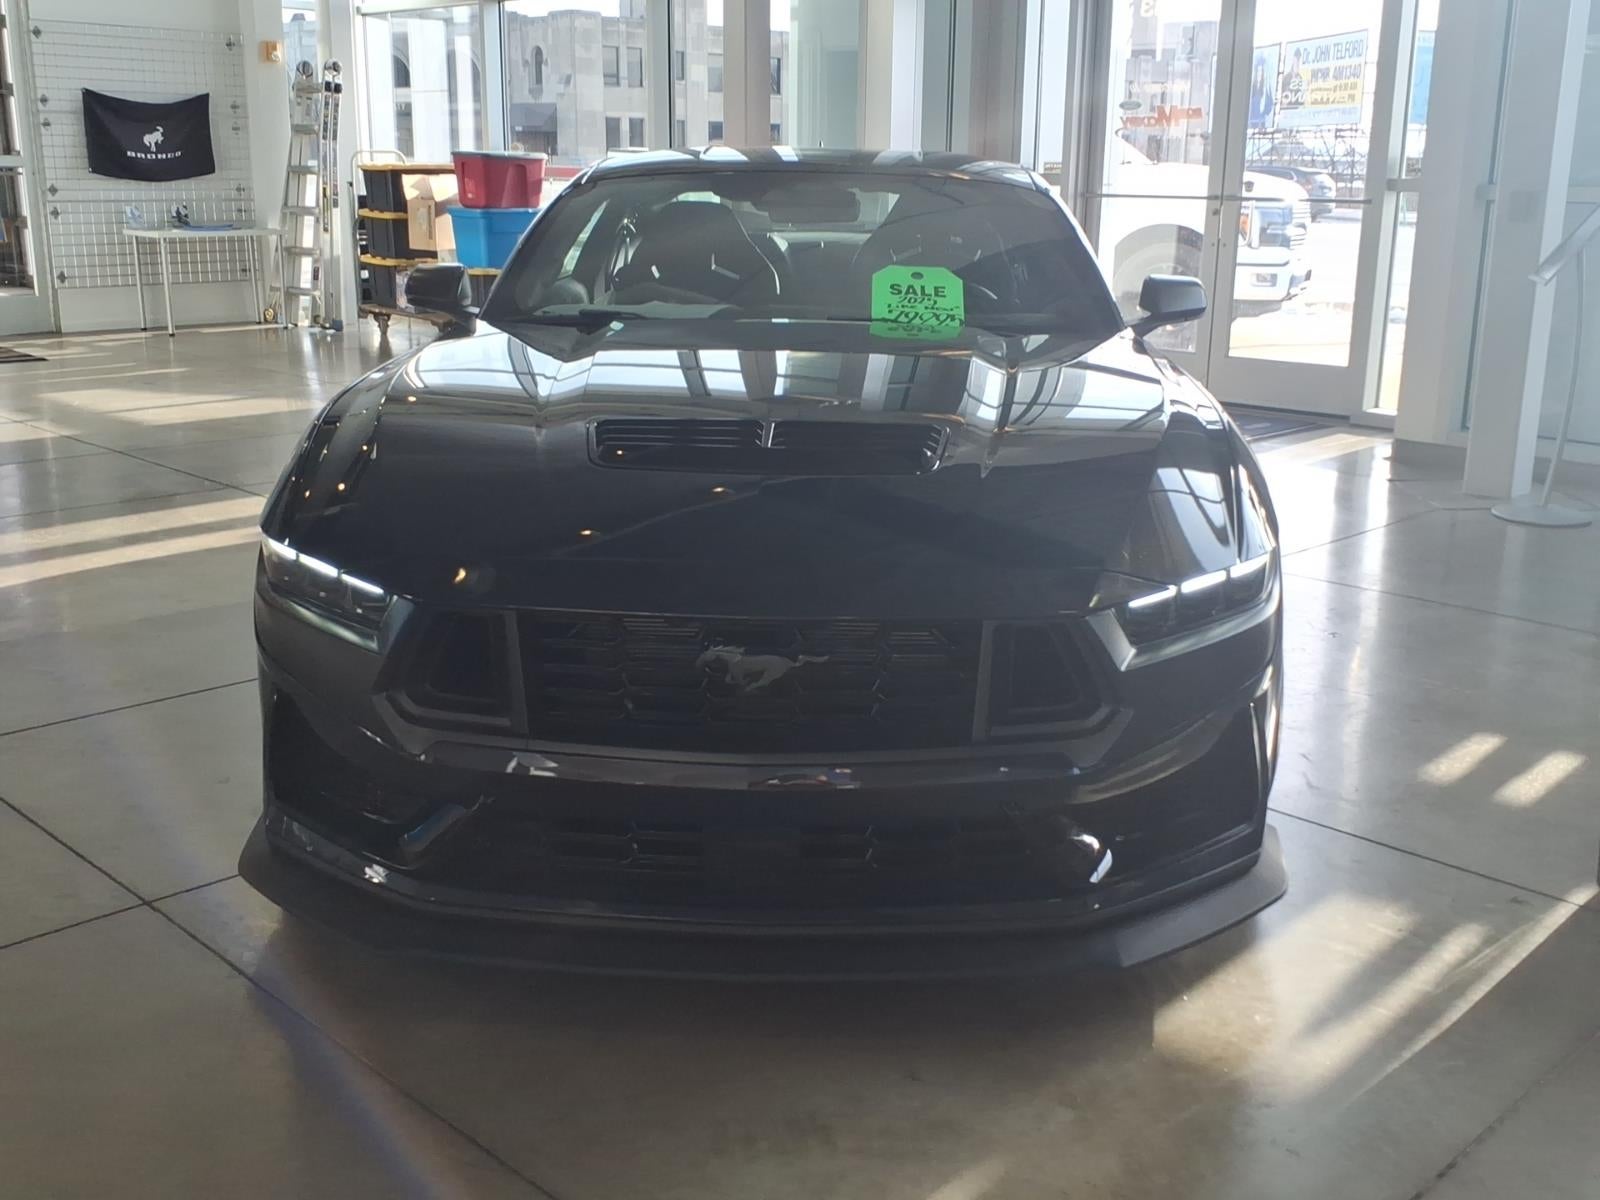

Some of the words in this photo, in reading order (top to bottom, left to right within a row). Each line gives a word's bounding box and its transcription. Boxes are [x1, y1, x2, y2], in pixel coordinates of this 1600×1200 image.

[1312, 44, 1331, 63] JOHN
[1332, 39, 1364, 61] TELFORD
[126, 150, 182, 160] BRONCO
[889, 283, 947, 298] SALE
